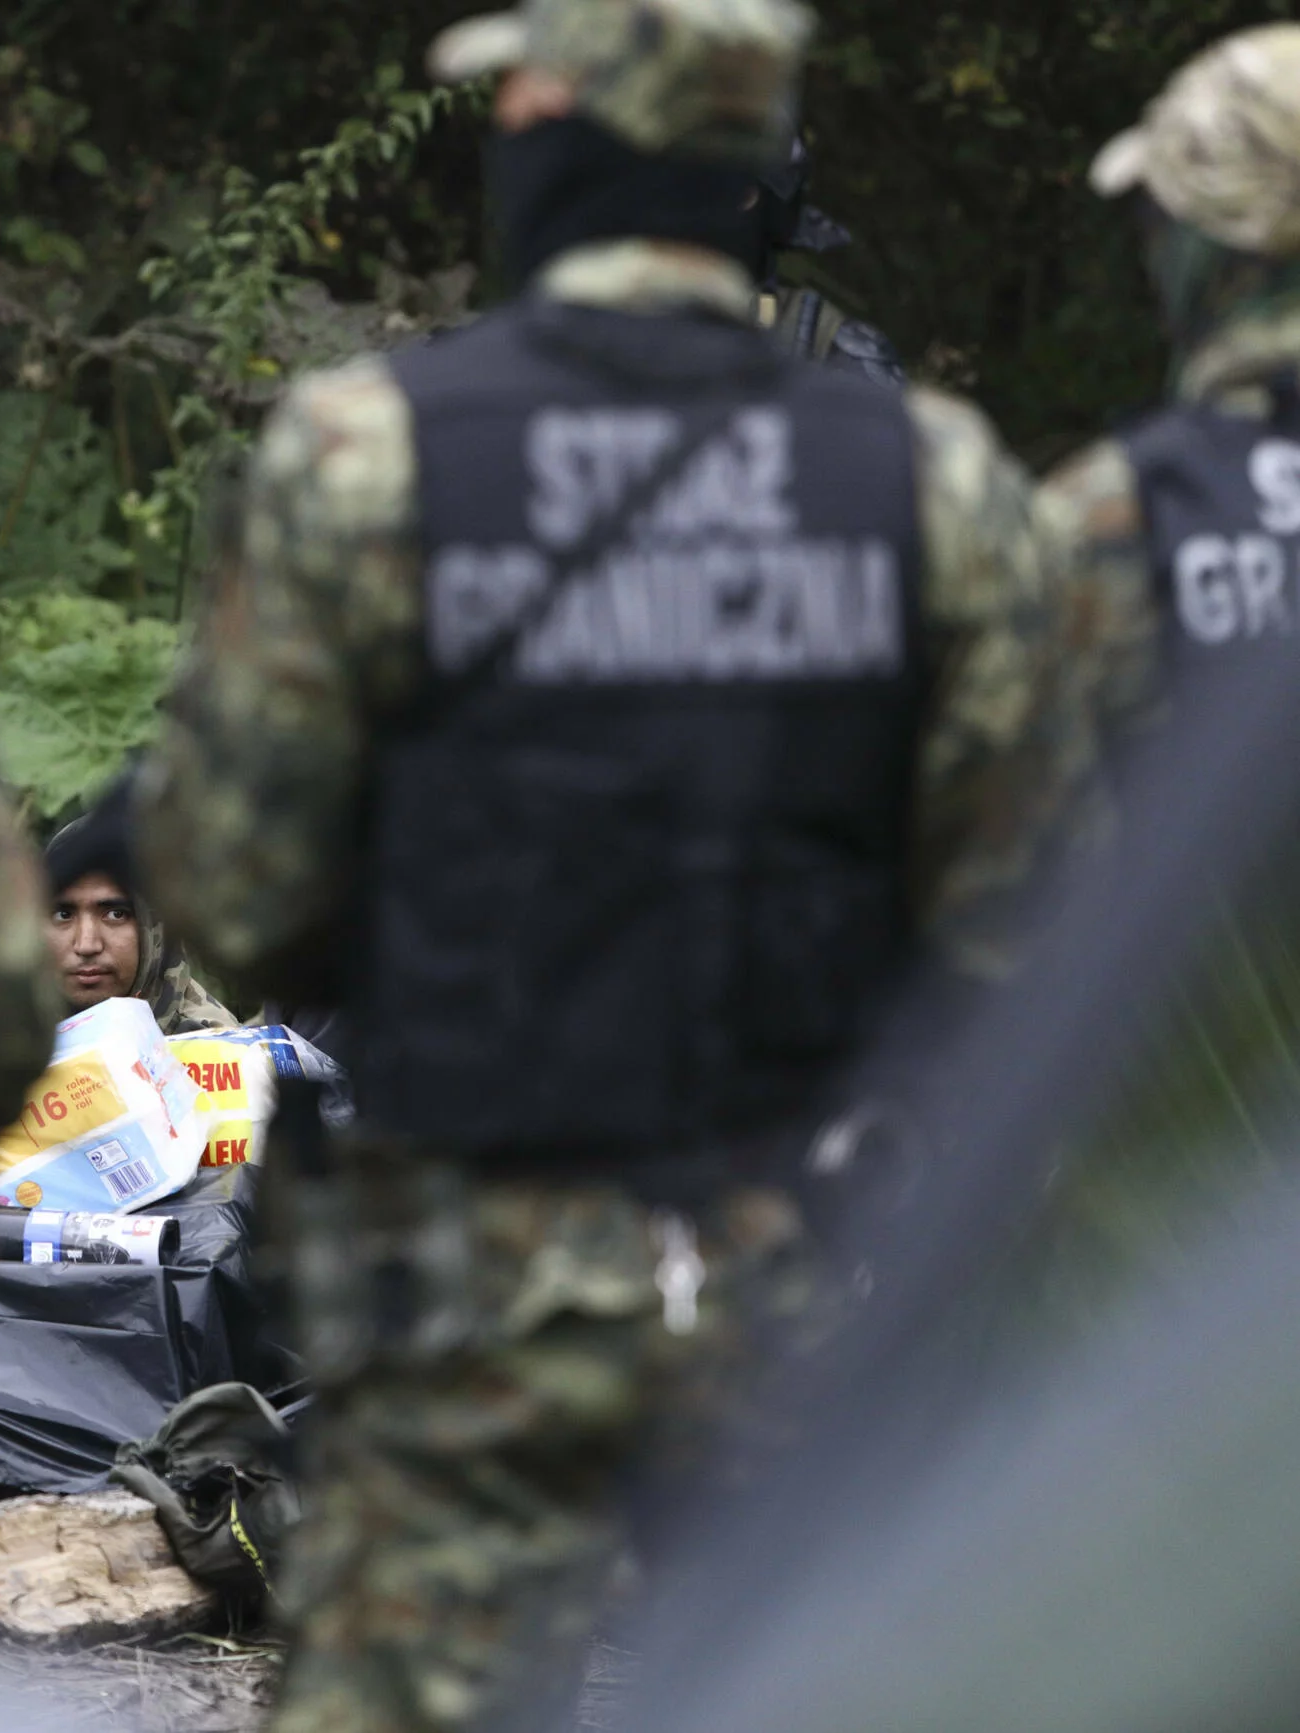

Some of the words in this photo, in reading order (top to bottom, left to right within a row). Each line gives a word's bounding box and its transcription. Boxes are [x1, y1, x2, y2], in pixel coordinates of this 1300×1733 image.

[1174, 532, 1300, 644] GR
[66, 1074, 92, 1091] rolek
[182, 1062, 241, 1092] MEG
[24, 1091, 67, 1128] 16
[199, 1138, 248, 1168] LEK
